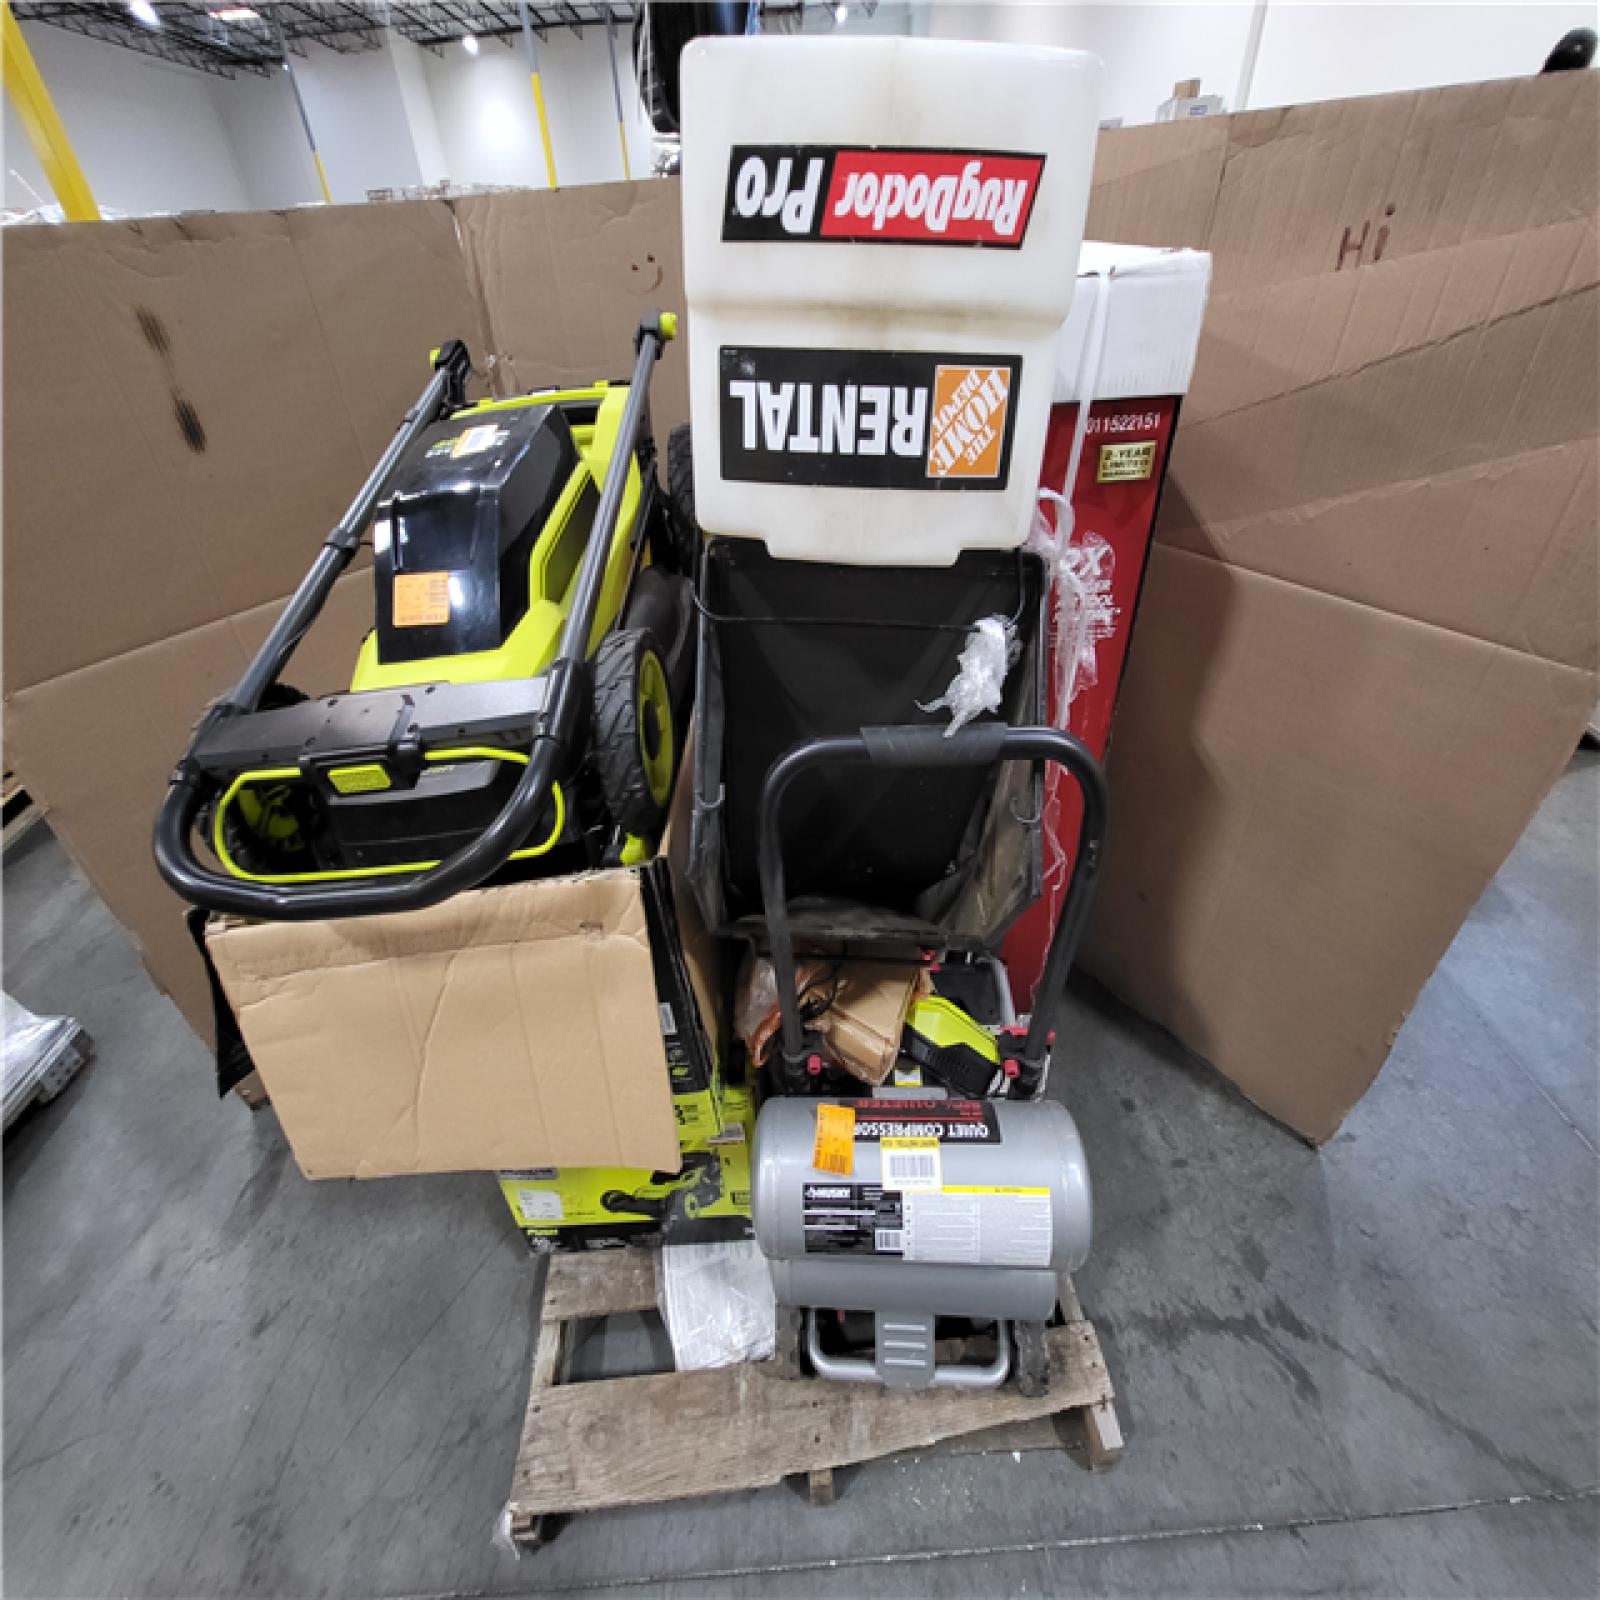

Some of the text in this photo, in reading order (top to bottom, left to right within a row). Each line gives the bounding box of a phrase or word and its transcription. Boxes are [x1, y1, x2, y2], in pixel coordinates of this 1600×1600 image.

[734, 156, 1028, 236] RugDoctor Pro
[1335, 204, 1396, 272] Hi
[729, 379, 929, 457] RENTAL
[930, 368, 1009, 477] HOME
[931, 367, 982, 437] DEPOT
[964, 427, 997, 466] THE
[947, 1122, 989, 1138] QUIET
